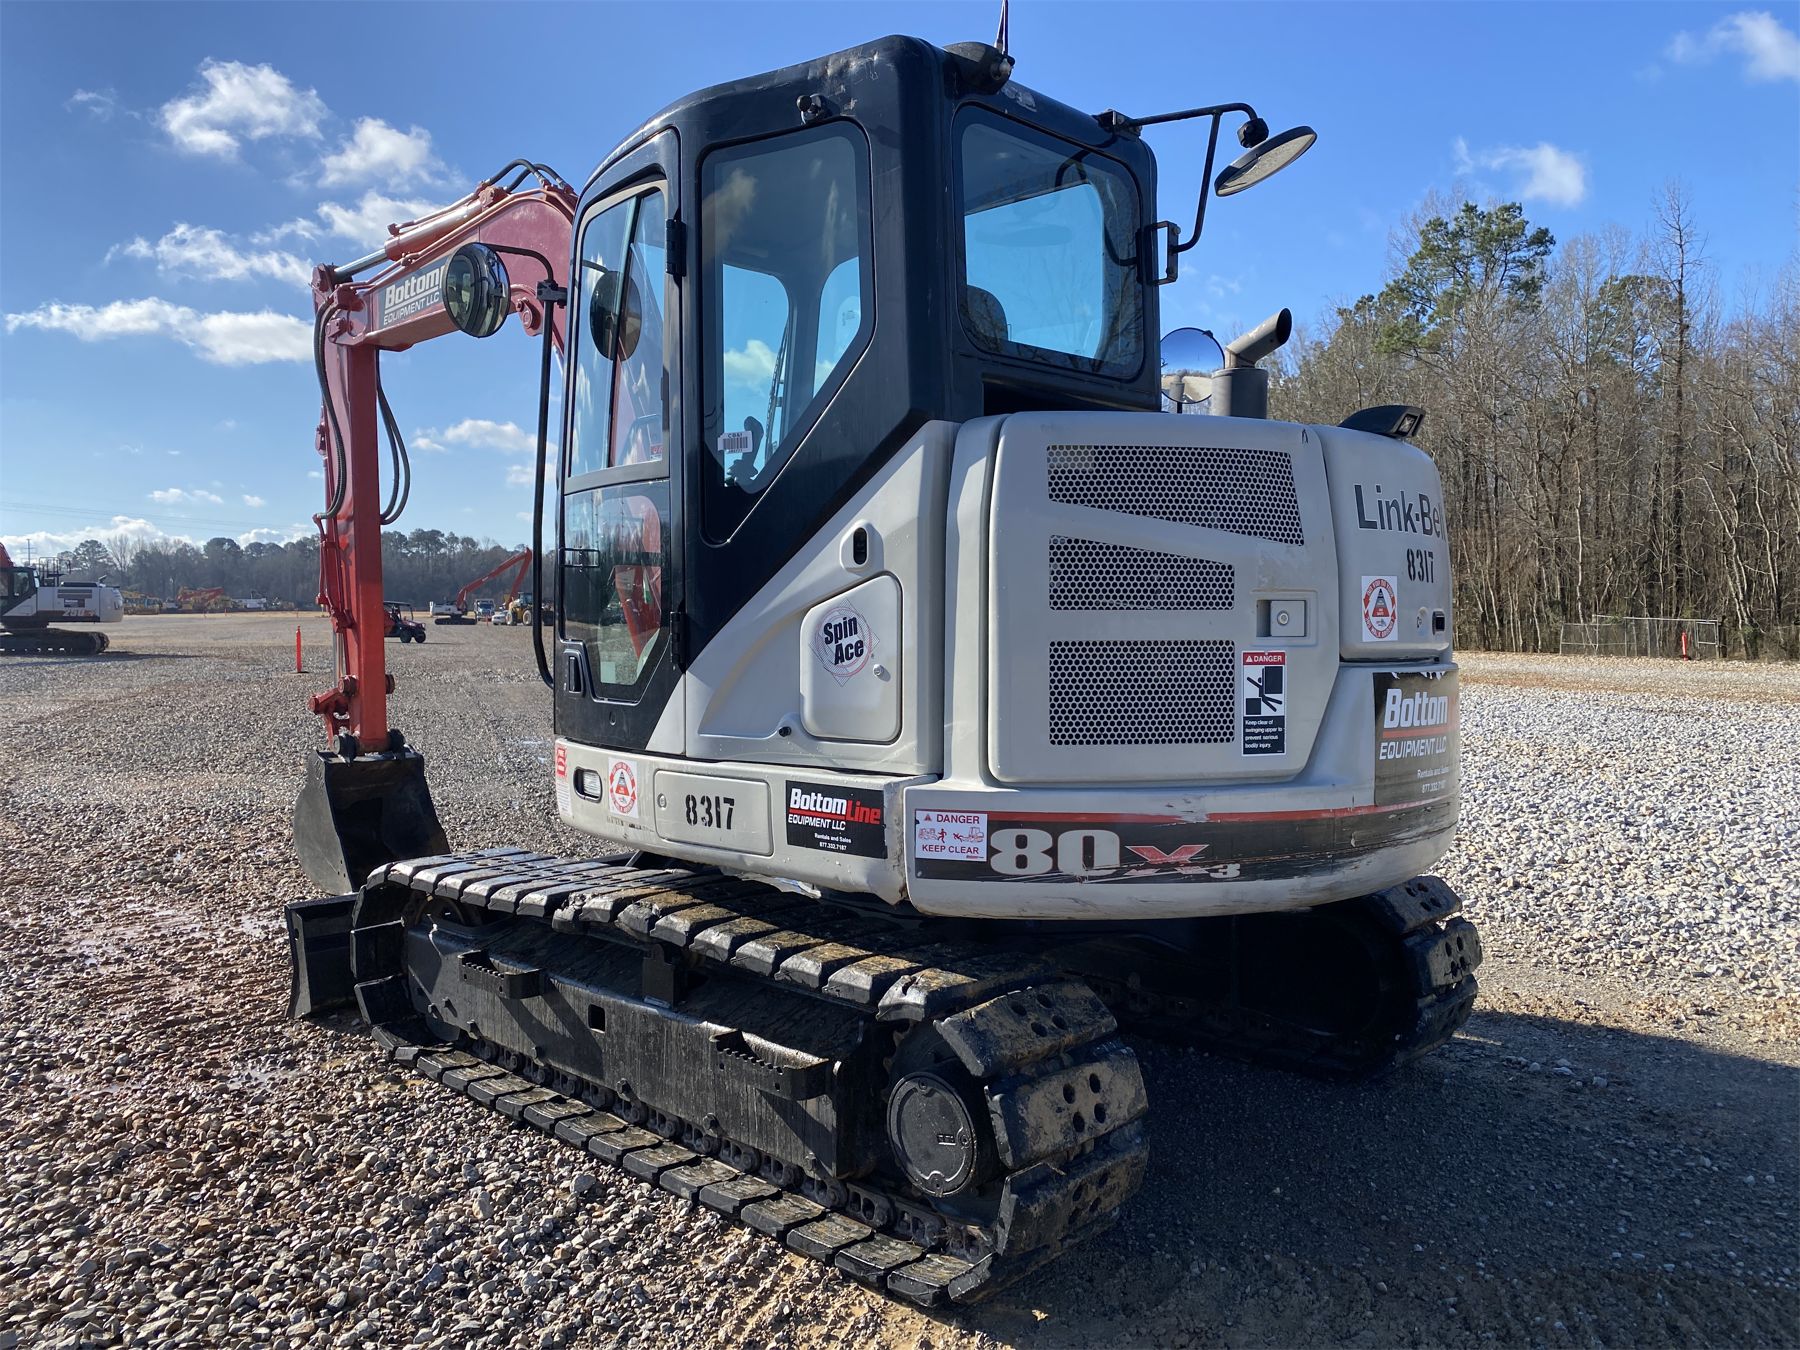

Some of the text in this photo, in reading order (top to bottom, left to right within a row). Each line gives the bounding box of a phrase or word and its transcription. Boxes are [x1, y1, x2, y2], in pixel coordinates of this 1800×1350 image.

[383, 291, 440, 325] EQUIPMENT LLC
[1406, 548, 1434, 583] 8317
[823, 616, 858, 645] Spin
[834, 639, 864, 666] Ace
[1253, 655, 1283, 663] DANGER
[1379, 736, 1447, 760] EQUIPMENT LLC
[685, 794, 735, 830] 8317
[788, 814, 847, 831] EQUIPMENT LLC
[936, 813, 980, 825] DANGER
[814, 832, 830, 841] Rentals
[839, 836, 852, 844] Sales
[922, 844, 979, 855] KEEP CLEAR
